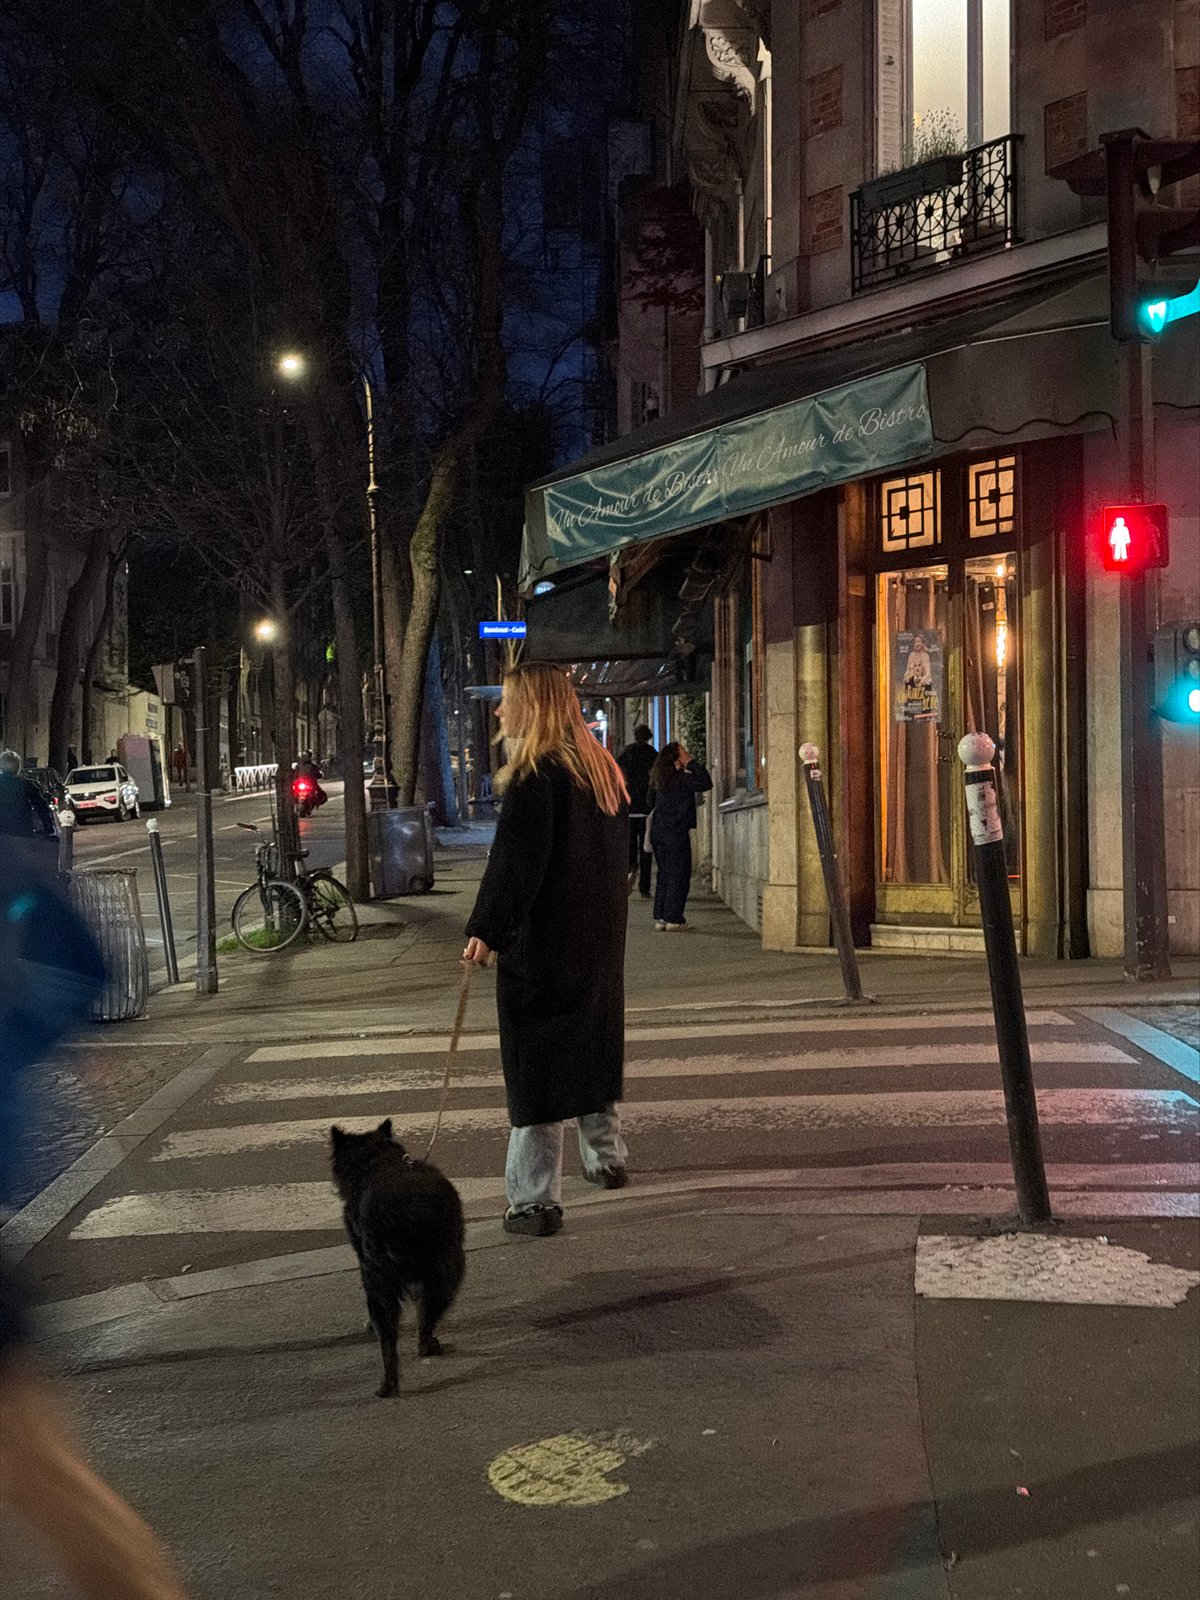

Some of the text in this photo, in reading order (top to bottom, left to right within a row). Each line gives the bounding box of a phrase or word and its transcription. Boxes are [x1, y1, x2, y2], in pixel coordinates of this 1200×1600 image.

[722, 404, 926, 477] Un Amour de Bistro
[553, 508, 577, 530] Un
[577, 492, 640, 527] Amour
[642, 485, 662, 504] de
